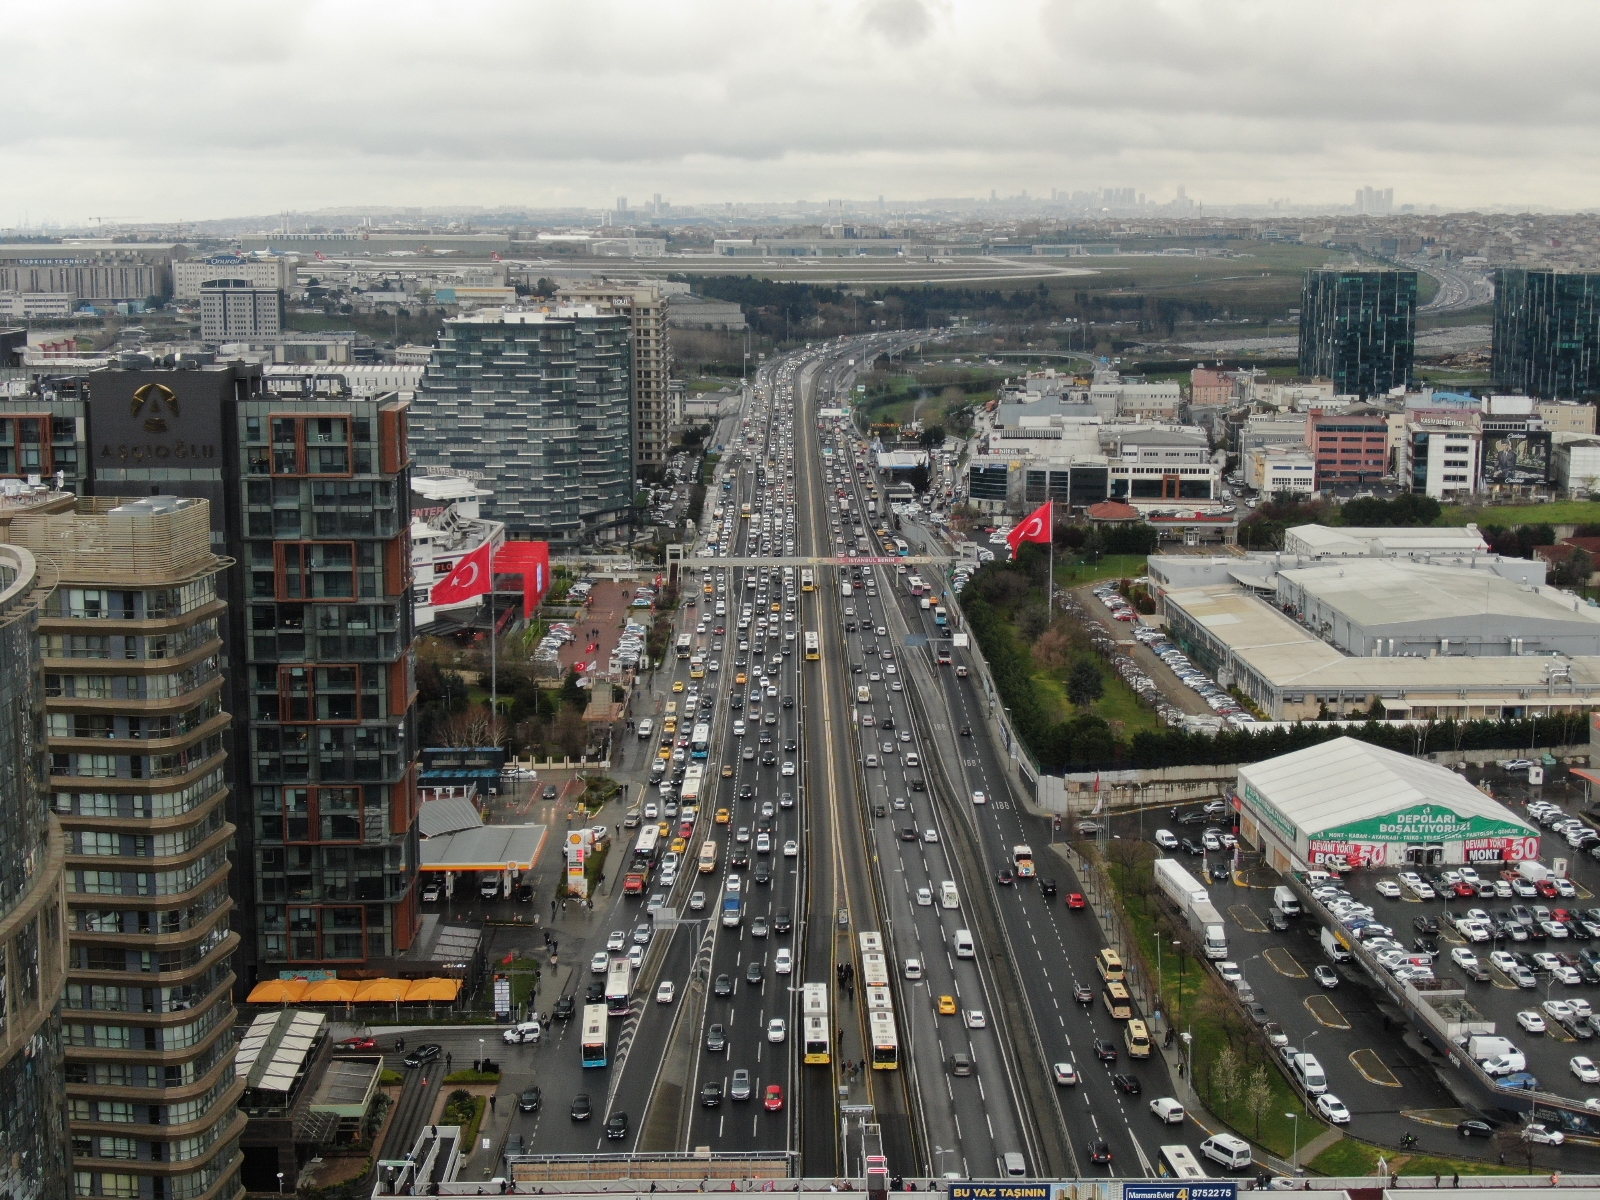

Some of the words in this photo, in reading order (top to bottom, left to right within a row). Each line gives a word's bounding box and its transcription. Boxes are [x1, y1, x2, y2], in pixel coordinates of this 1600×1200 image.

[100, 440, 214, 463] AŞÇIOĞLU
[435, 563, 452, 572] FLO
[1397, 814, 1456, 824] DEPOLARI
[1511, 837, 1538, 860] 50
[1469, 849, 1500, 861] MONT
[953, 1188, 970, 1197] BU
[973, 1188, 996, 1197] YAZ
[999, 1188, 1046, 1198] TAŞININ
